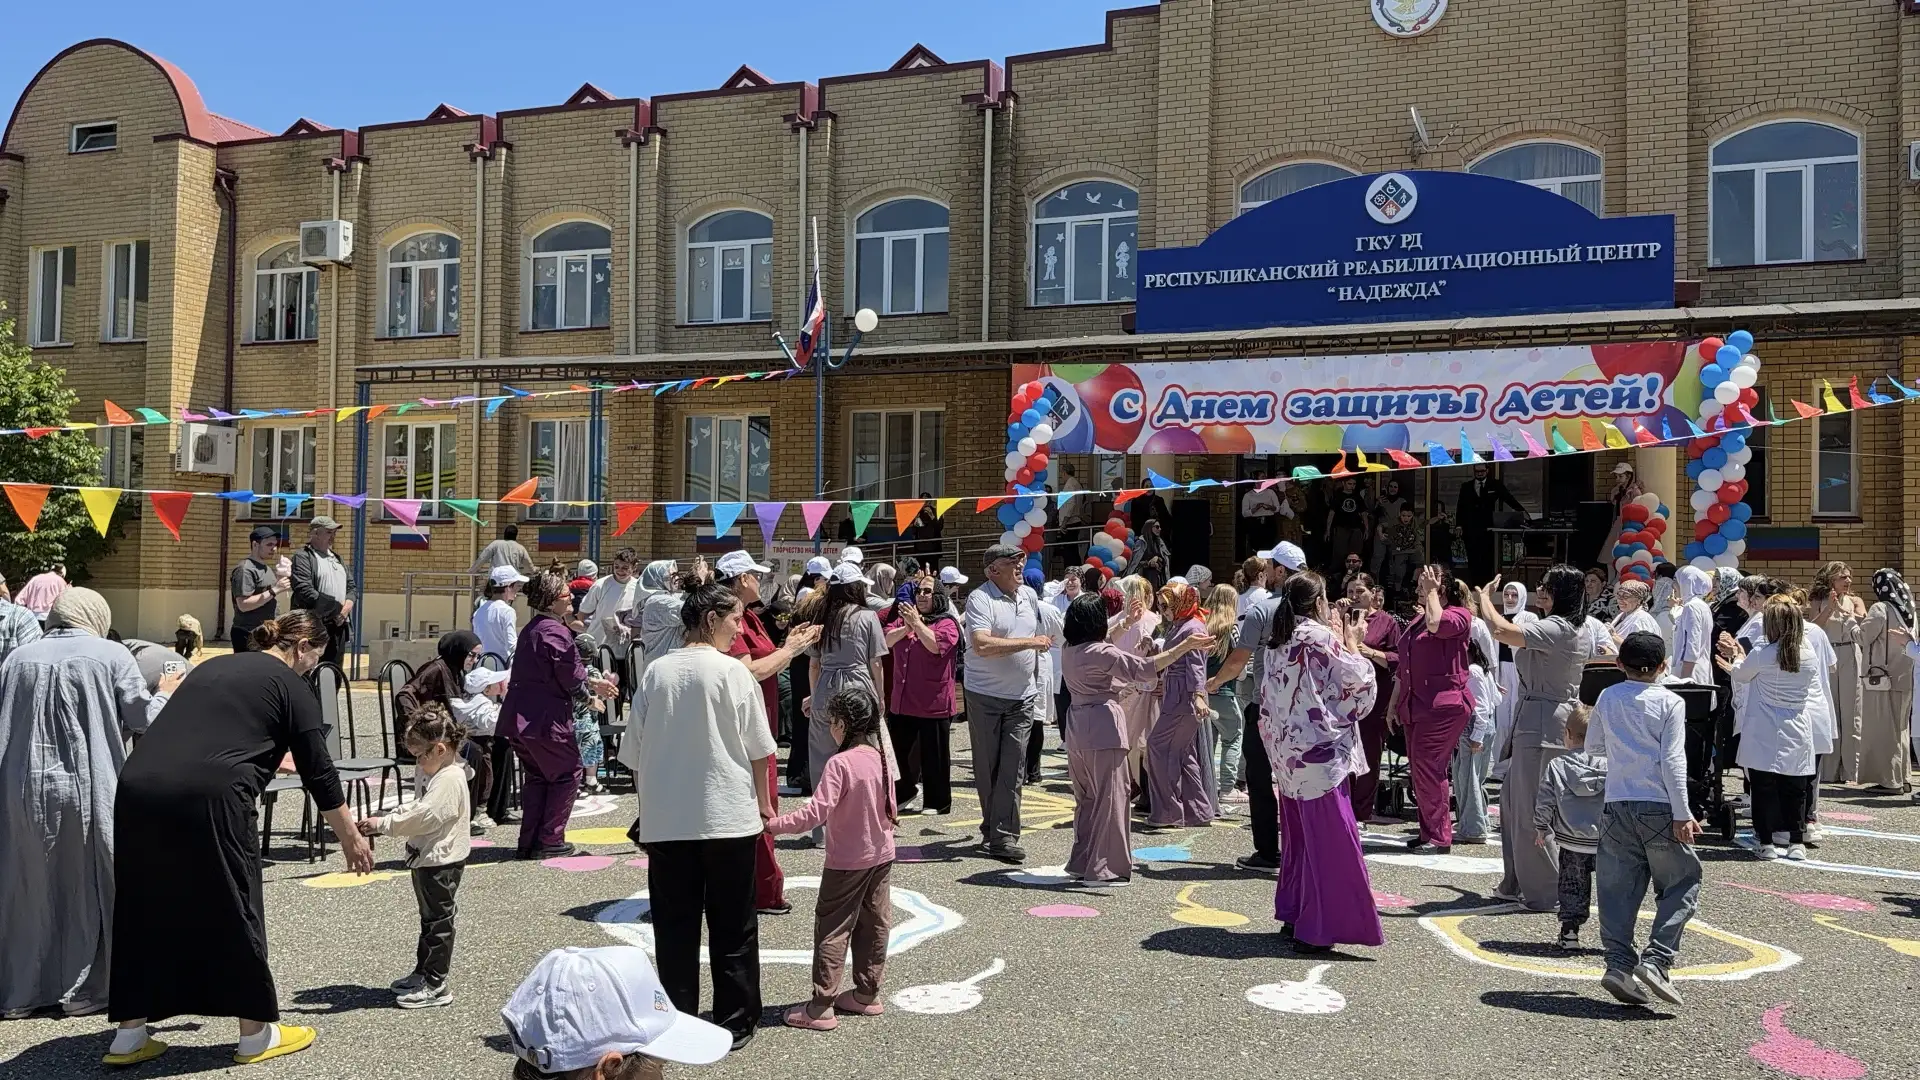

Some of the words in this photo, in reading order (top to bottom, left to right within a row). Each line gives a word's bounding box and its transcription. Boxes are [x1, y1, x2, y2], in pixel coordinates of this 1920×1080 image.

[1355, 234, 1396, 252] ГКУ
[1400, 232, 1423, 252] РД
[1144, 259, 1340, 289] РЕСПУБЛИКАНСКИЙ
[1343, 243, 1582, 277] РЕАБИЛИТАЦИОННЫЙ
[1586, 242, 1662, 264] ЦЕНТР
[1156, 390, 1272, 424] Днем
[1288, 391, 1478, 421] защиты
[1498, 376, 1660, 417] детей!
[772, 546, 803, 554] ТВОРЧЕСТВО
